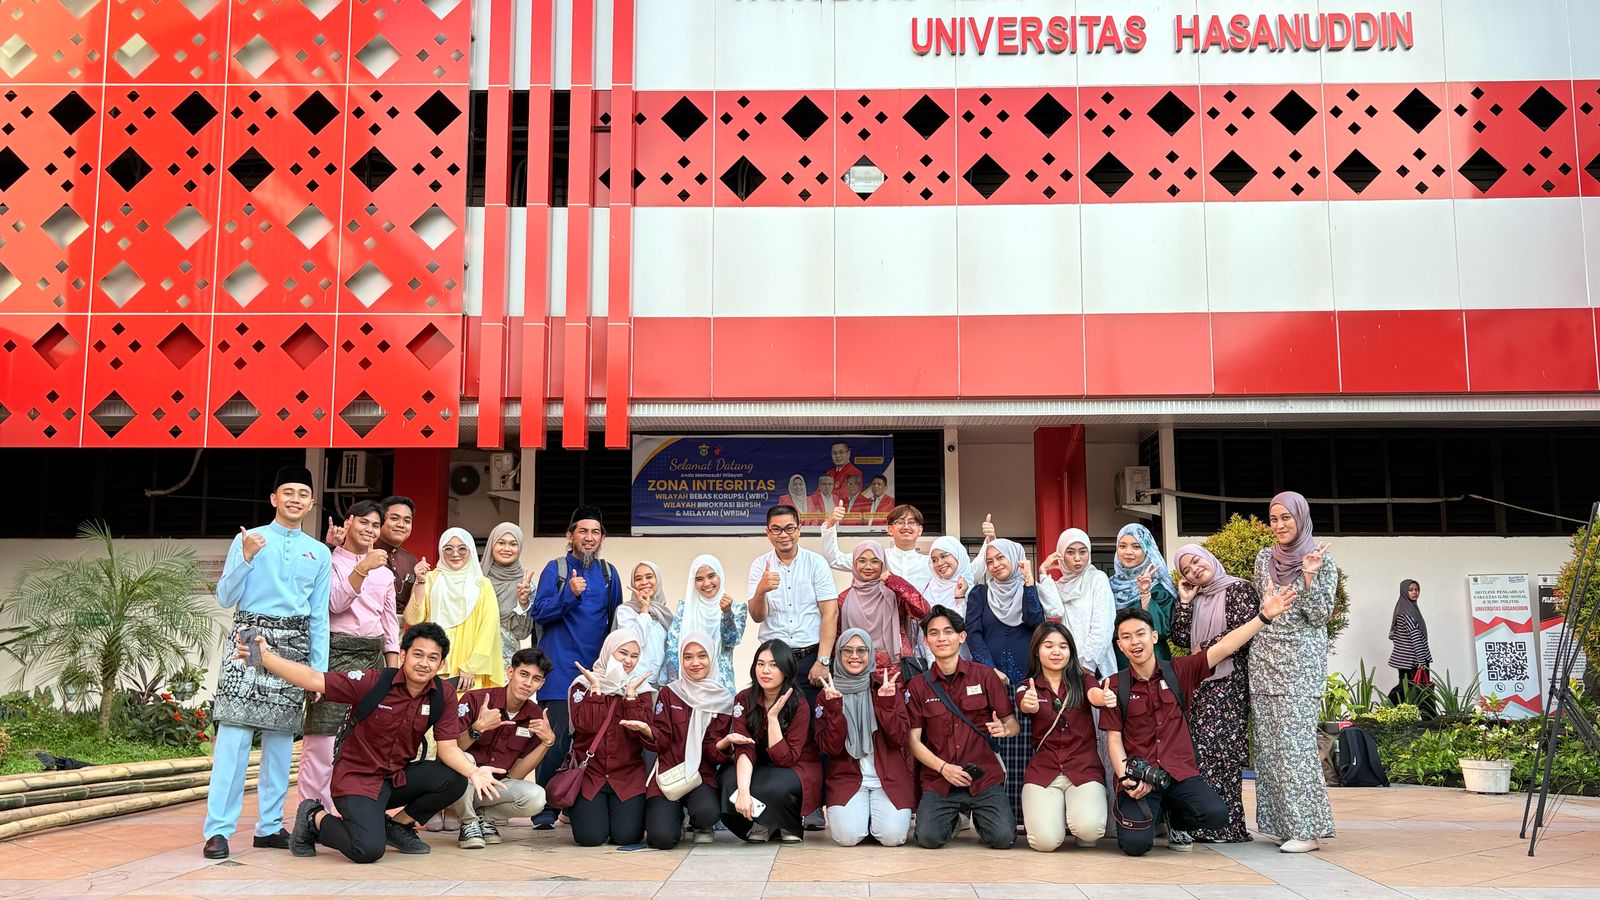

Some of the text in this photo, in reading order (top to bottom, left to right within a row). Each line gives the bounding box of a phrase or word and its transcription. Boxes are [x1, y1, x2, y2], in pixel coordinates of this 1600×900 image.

[911, 12, 1414, 55] UNIVERSITAS HASANUDDIN
[669, 458, 754, 474] Selamat Datang
[647, 480, 776, 491] ZONA INTEGRITAS
[745, 491, 769, 501] (WBK)
